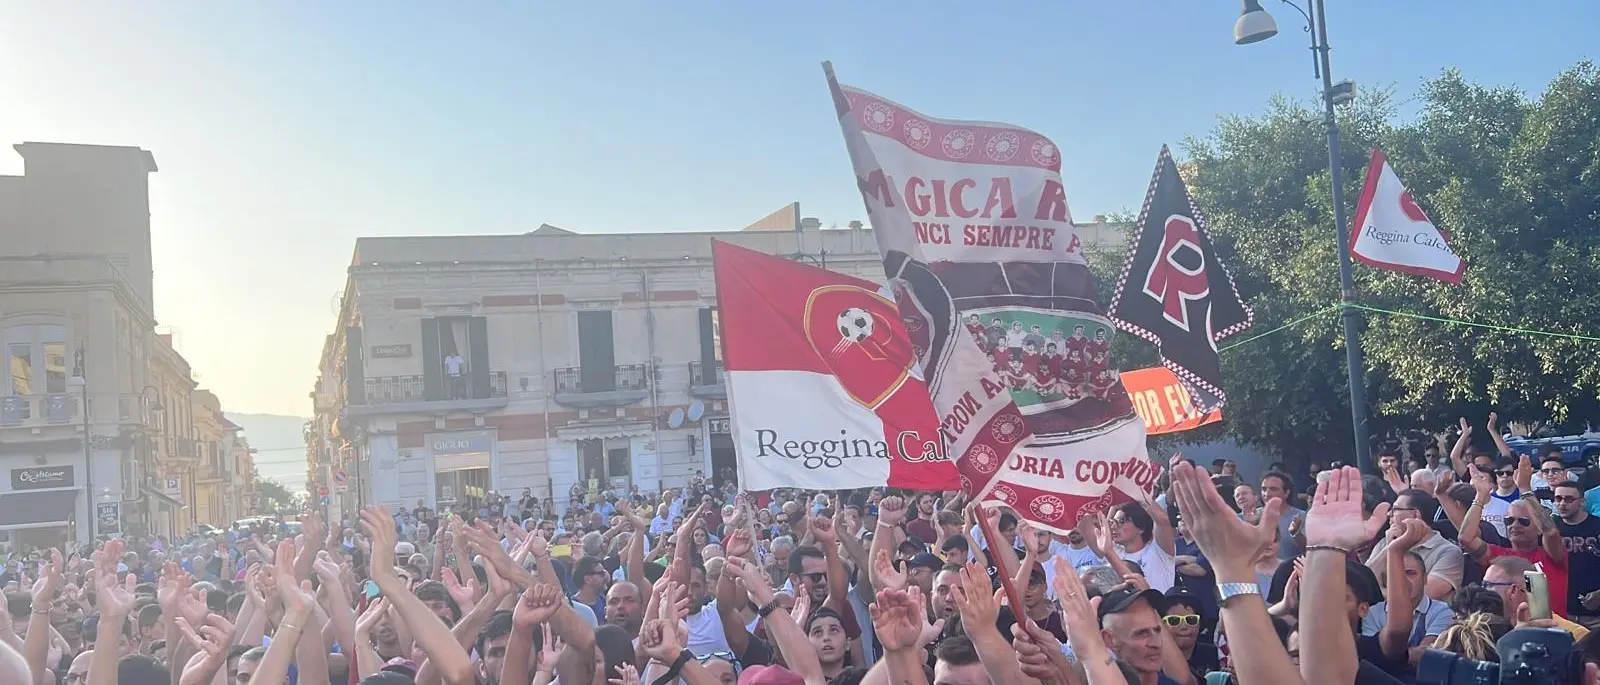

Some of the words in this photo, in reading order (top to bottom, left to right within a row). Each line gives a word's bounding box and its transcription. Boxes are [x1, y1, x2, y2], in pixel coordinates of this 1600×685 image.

[963, 224, 1056, 250] SEMPRE
[1365, 225, 1409, 246] Reggina
[1128, 388, 1168, 428] OR
[755, 429, 892, 469] Reggina
[169, 480, 176, 488] P
